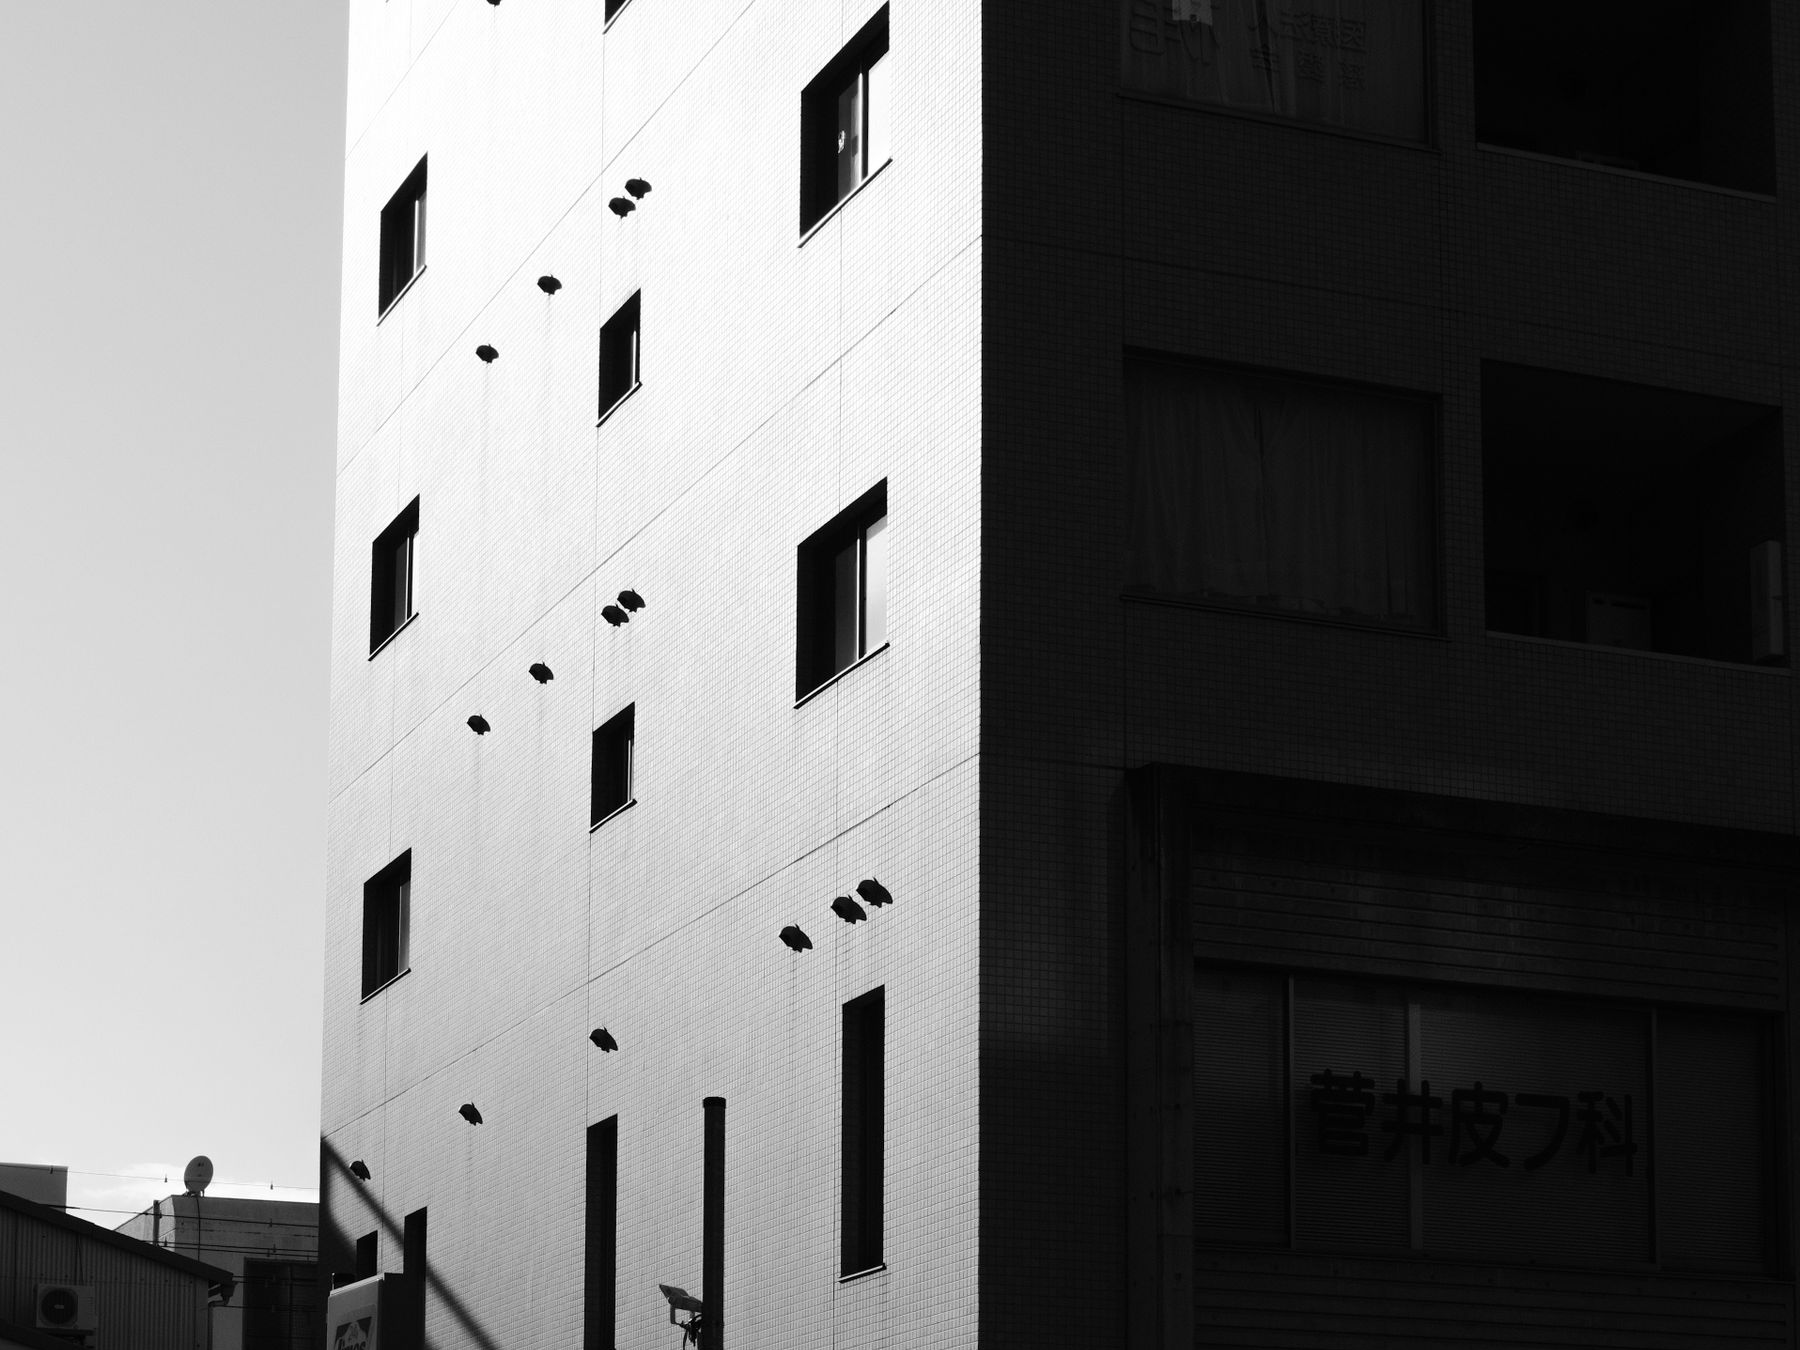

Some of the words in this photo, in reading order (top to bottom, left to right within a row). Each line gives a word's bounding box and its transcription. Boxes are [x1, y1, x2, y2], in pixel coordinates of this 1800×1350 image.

[1309, 1068, 1638, 1177] 菅井皮フ科
